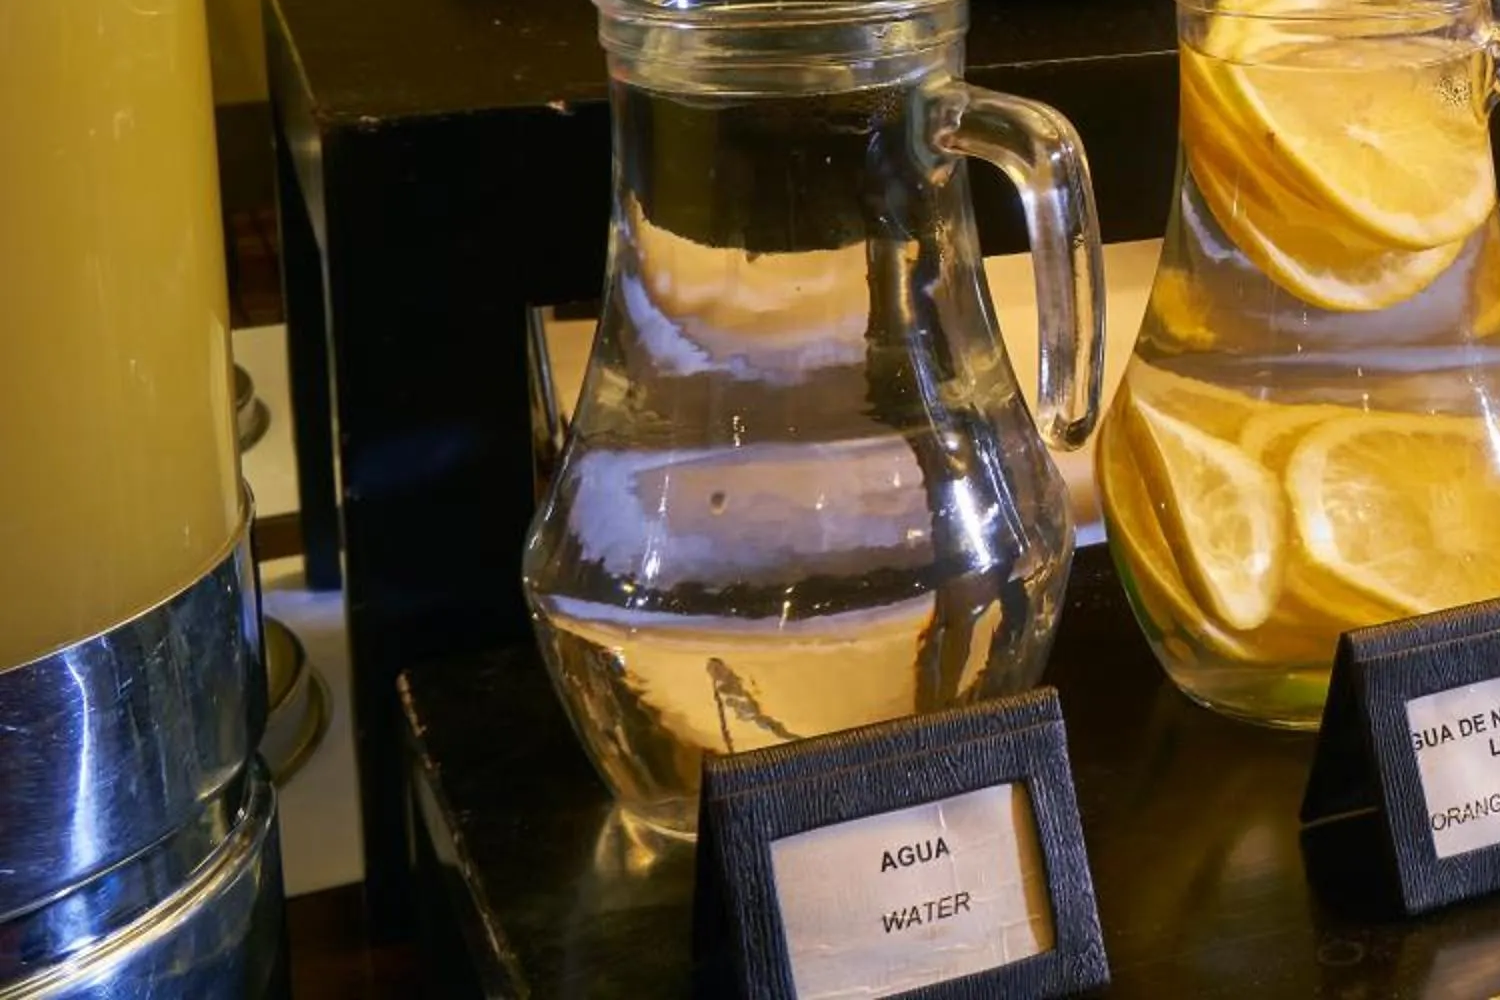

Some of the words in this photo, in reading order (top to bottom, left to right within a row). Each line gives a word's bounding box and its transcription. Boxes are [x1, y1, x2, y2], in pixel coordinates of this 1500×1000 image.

[1412, 724, 1455, 751] GUA
[1459, 713, 1487, 738] DE
[880, 837, 951, 872] AGUA
[881, 891, 971, 933] WATER
